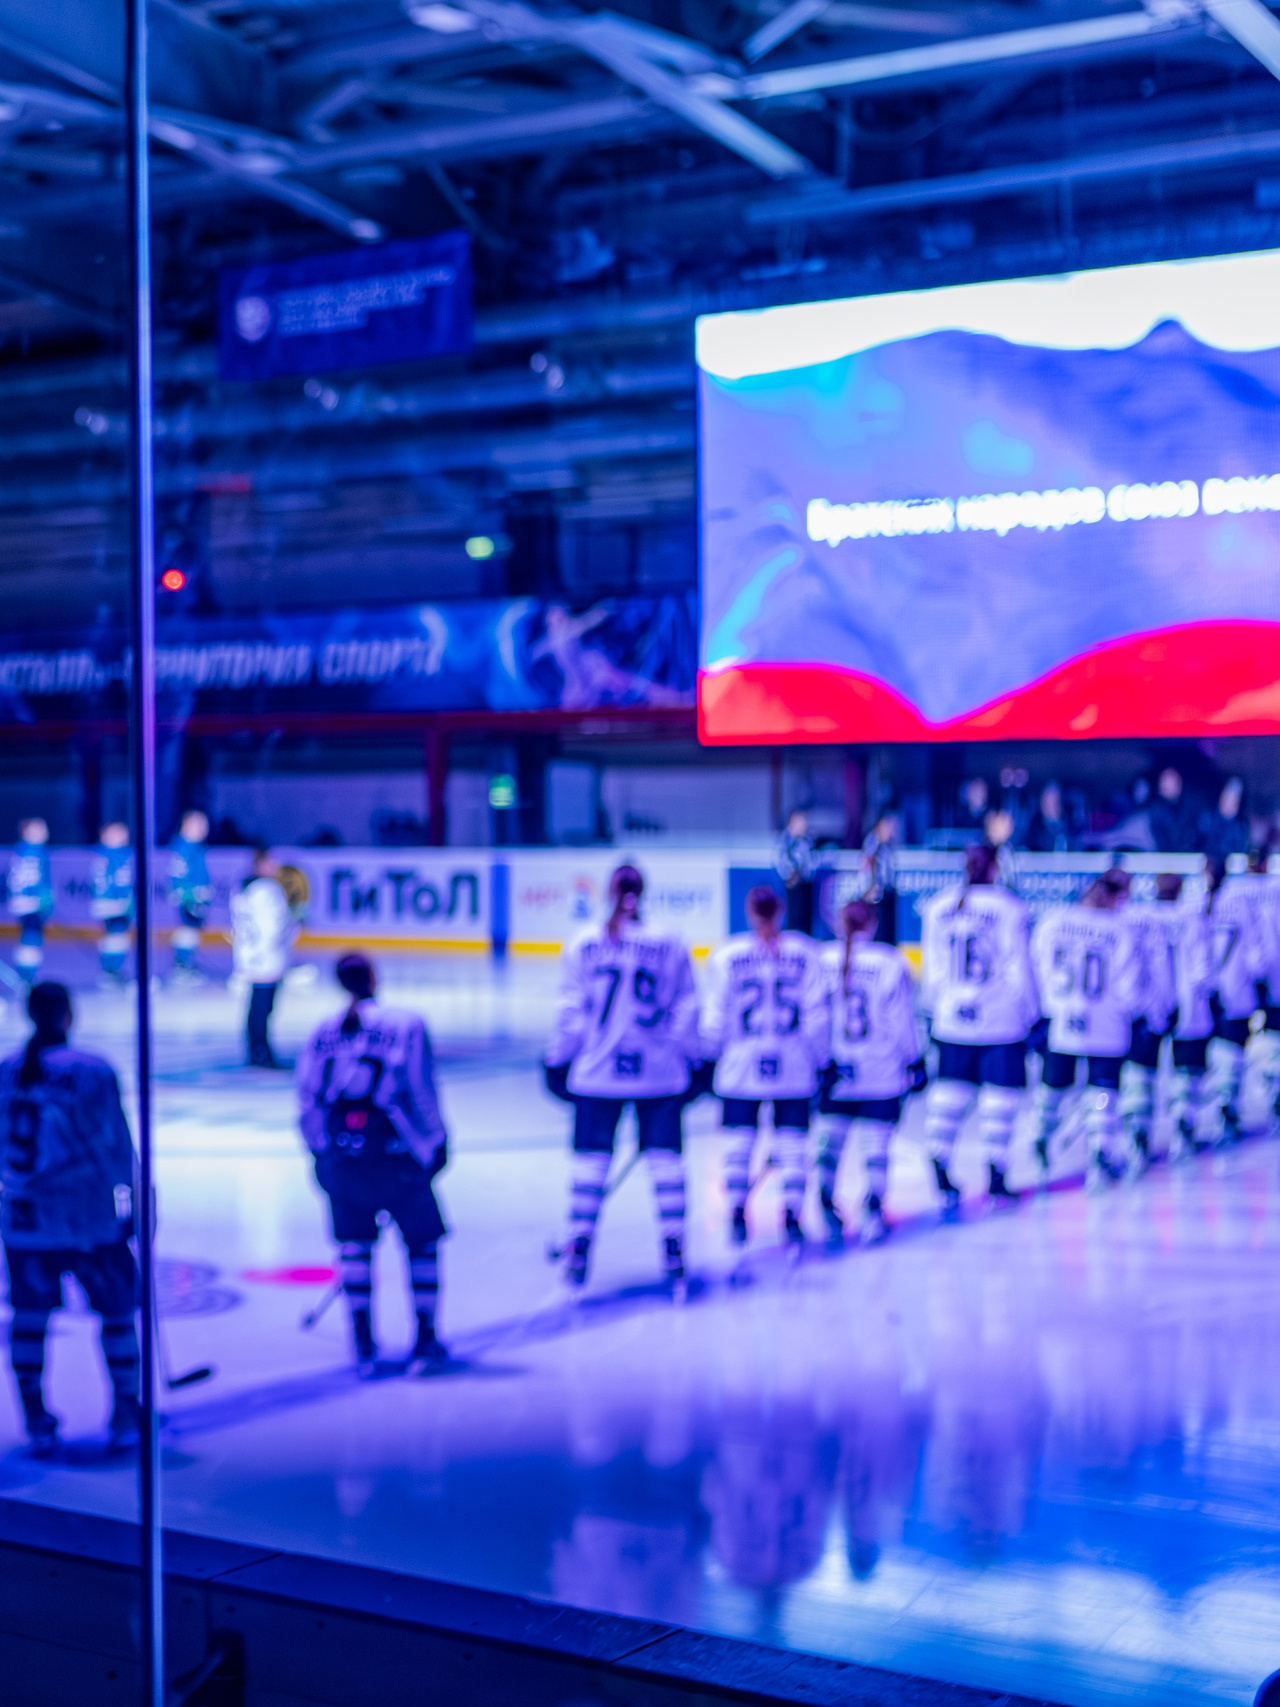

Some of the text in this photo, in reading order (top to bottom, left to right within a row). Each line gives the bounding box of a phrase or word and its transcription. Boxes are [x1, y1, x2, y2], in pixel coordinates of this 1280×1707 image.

[593, 964, 666, 1030] 79
[739, 977, 801, 1036] 25
[7, 1099, 39, 1172] 9
